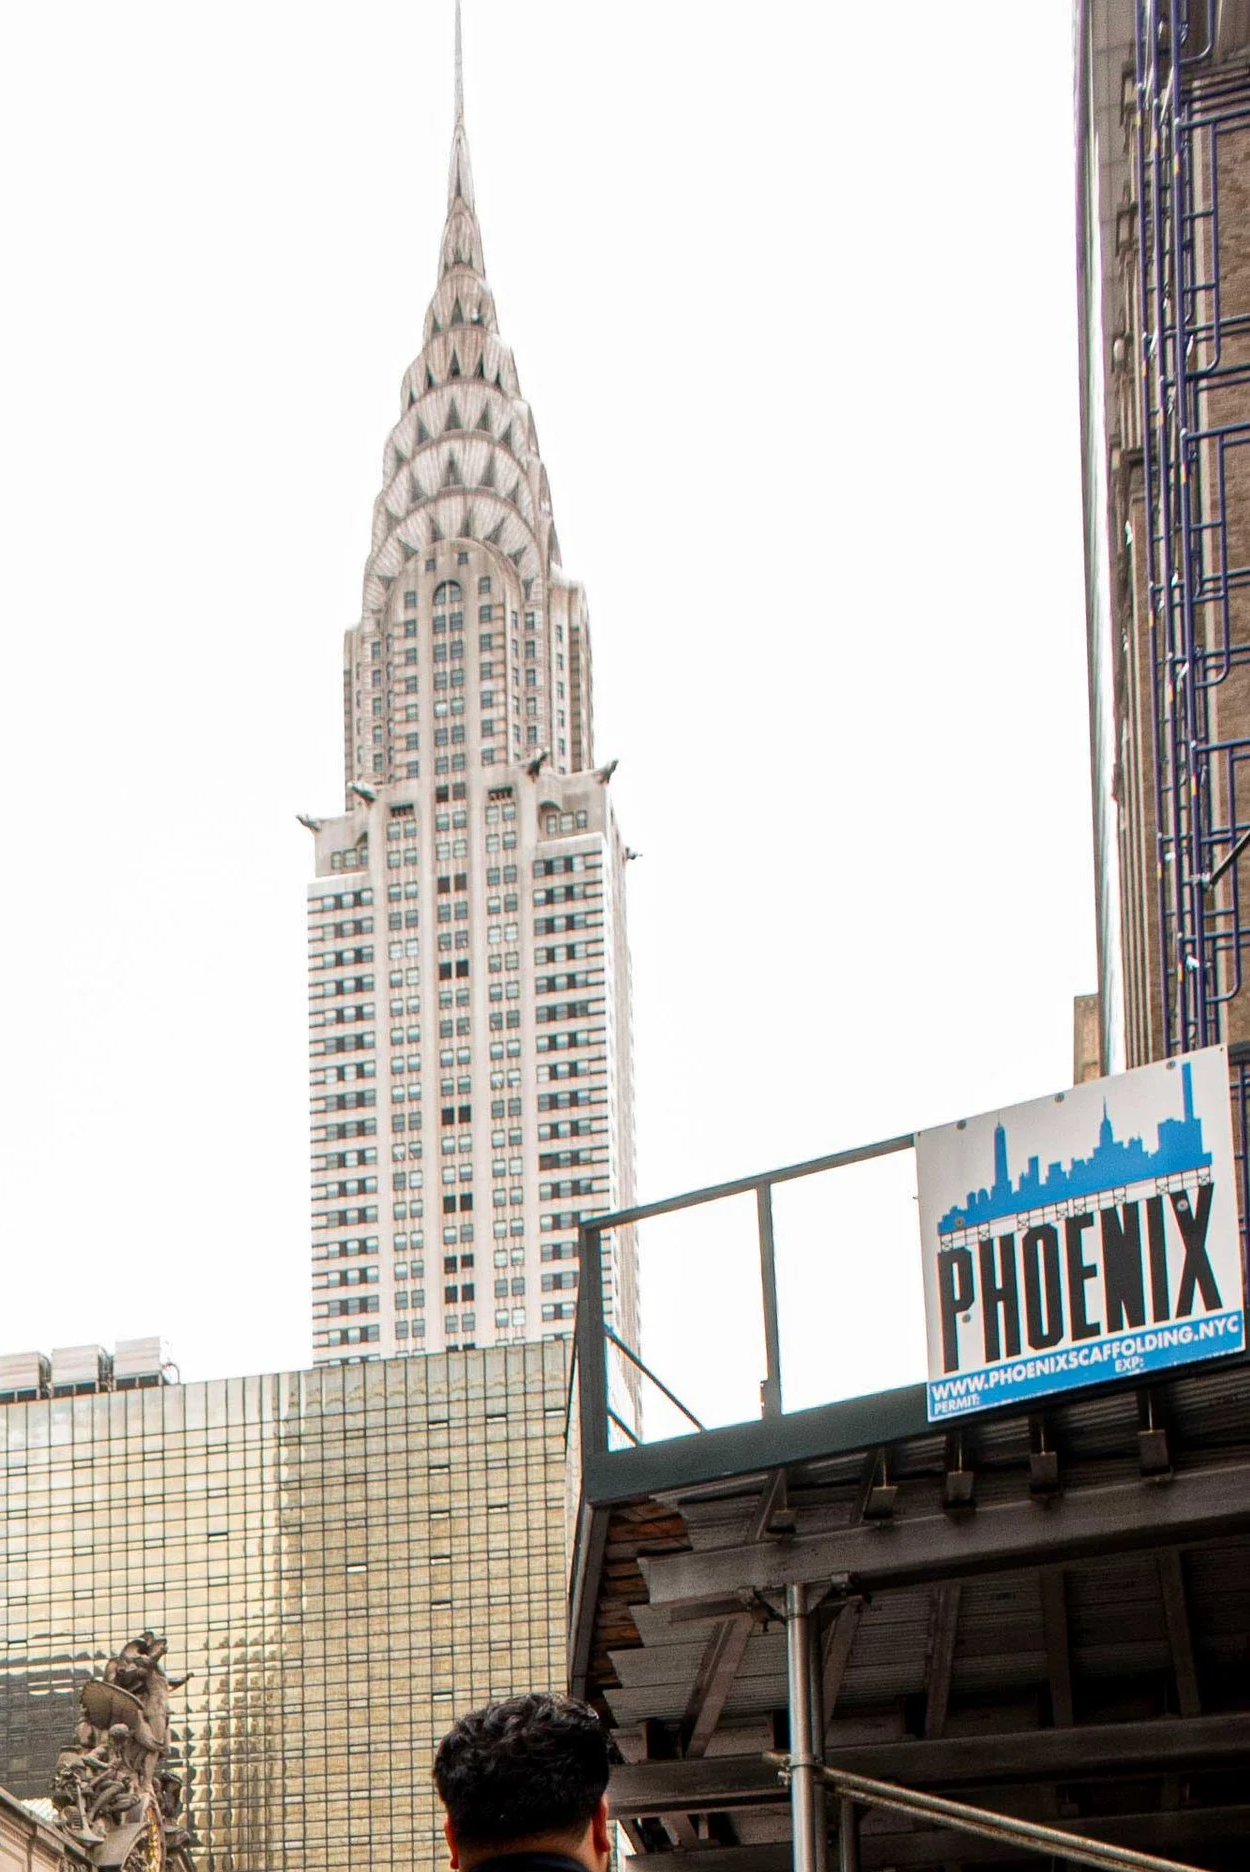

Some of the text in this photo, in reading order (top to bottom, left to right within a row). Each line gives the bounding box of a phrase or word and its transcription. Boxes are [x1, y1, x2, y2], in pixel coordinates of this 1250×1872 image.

[936, 1182, 1223, 1375] PHOENIX
[931, 1315, 1240, 1401] WWW.PHOENIXSCAFFOLDING.NYC
[1114, 1355, 1144, 1373] EXP:
[932, 1394, 981, 1416] PERMIT:
